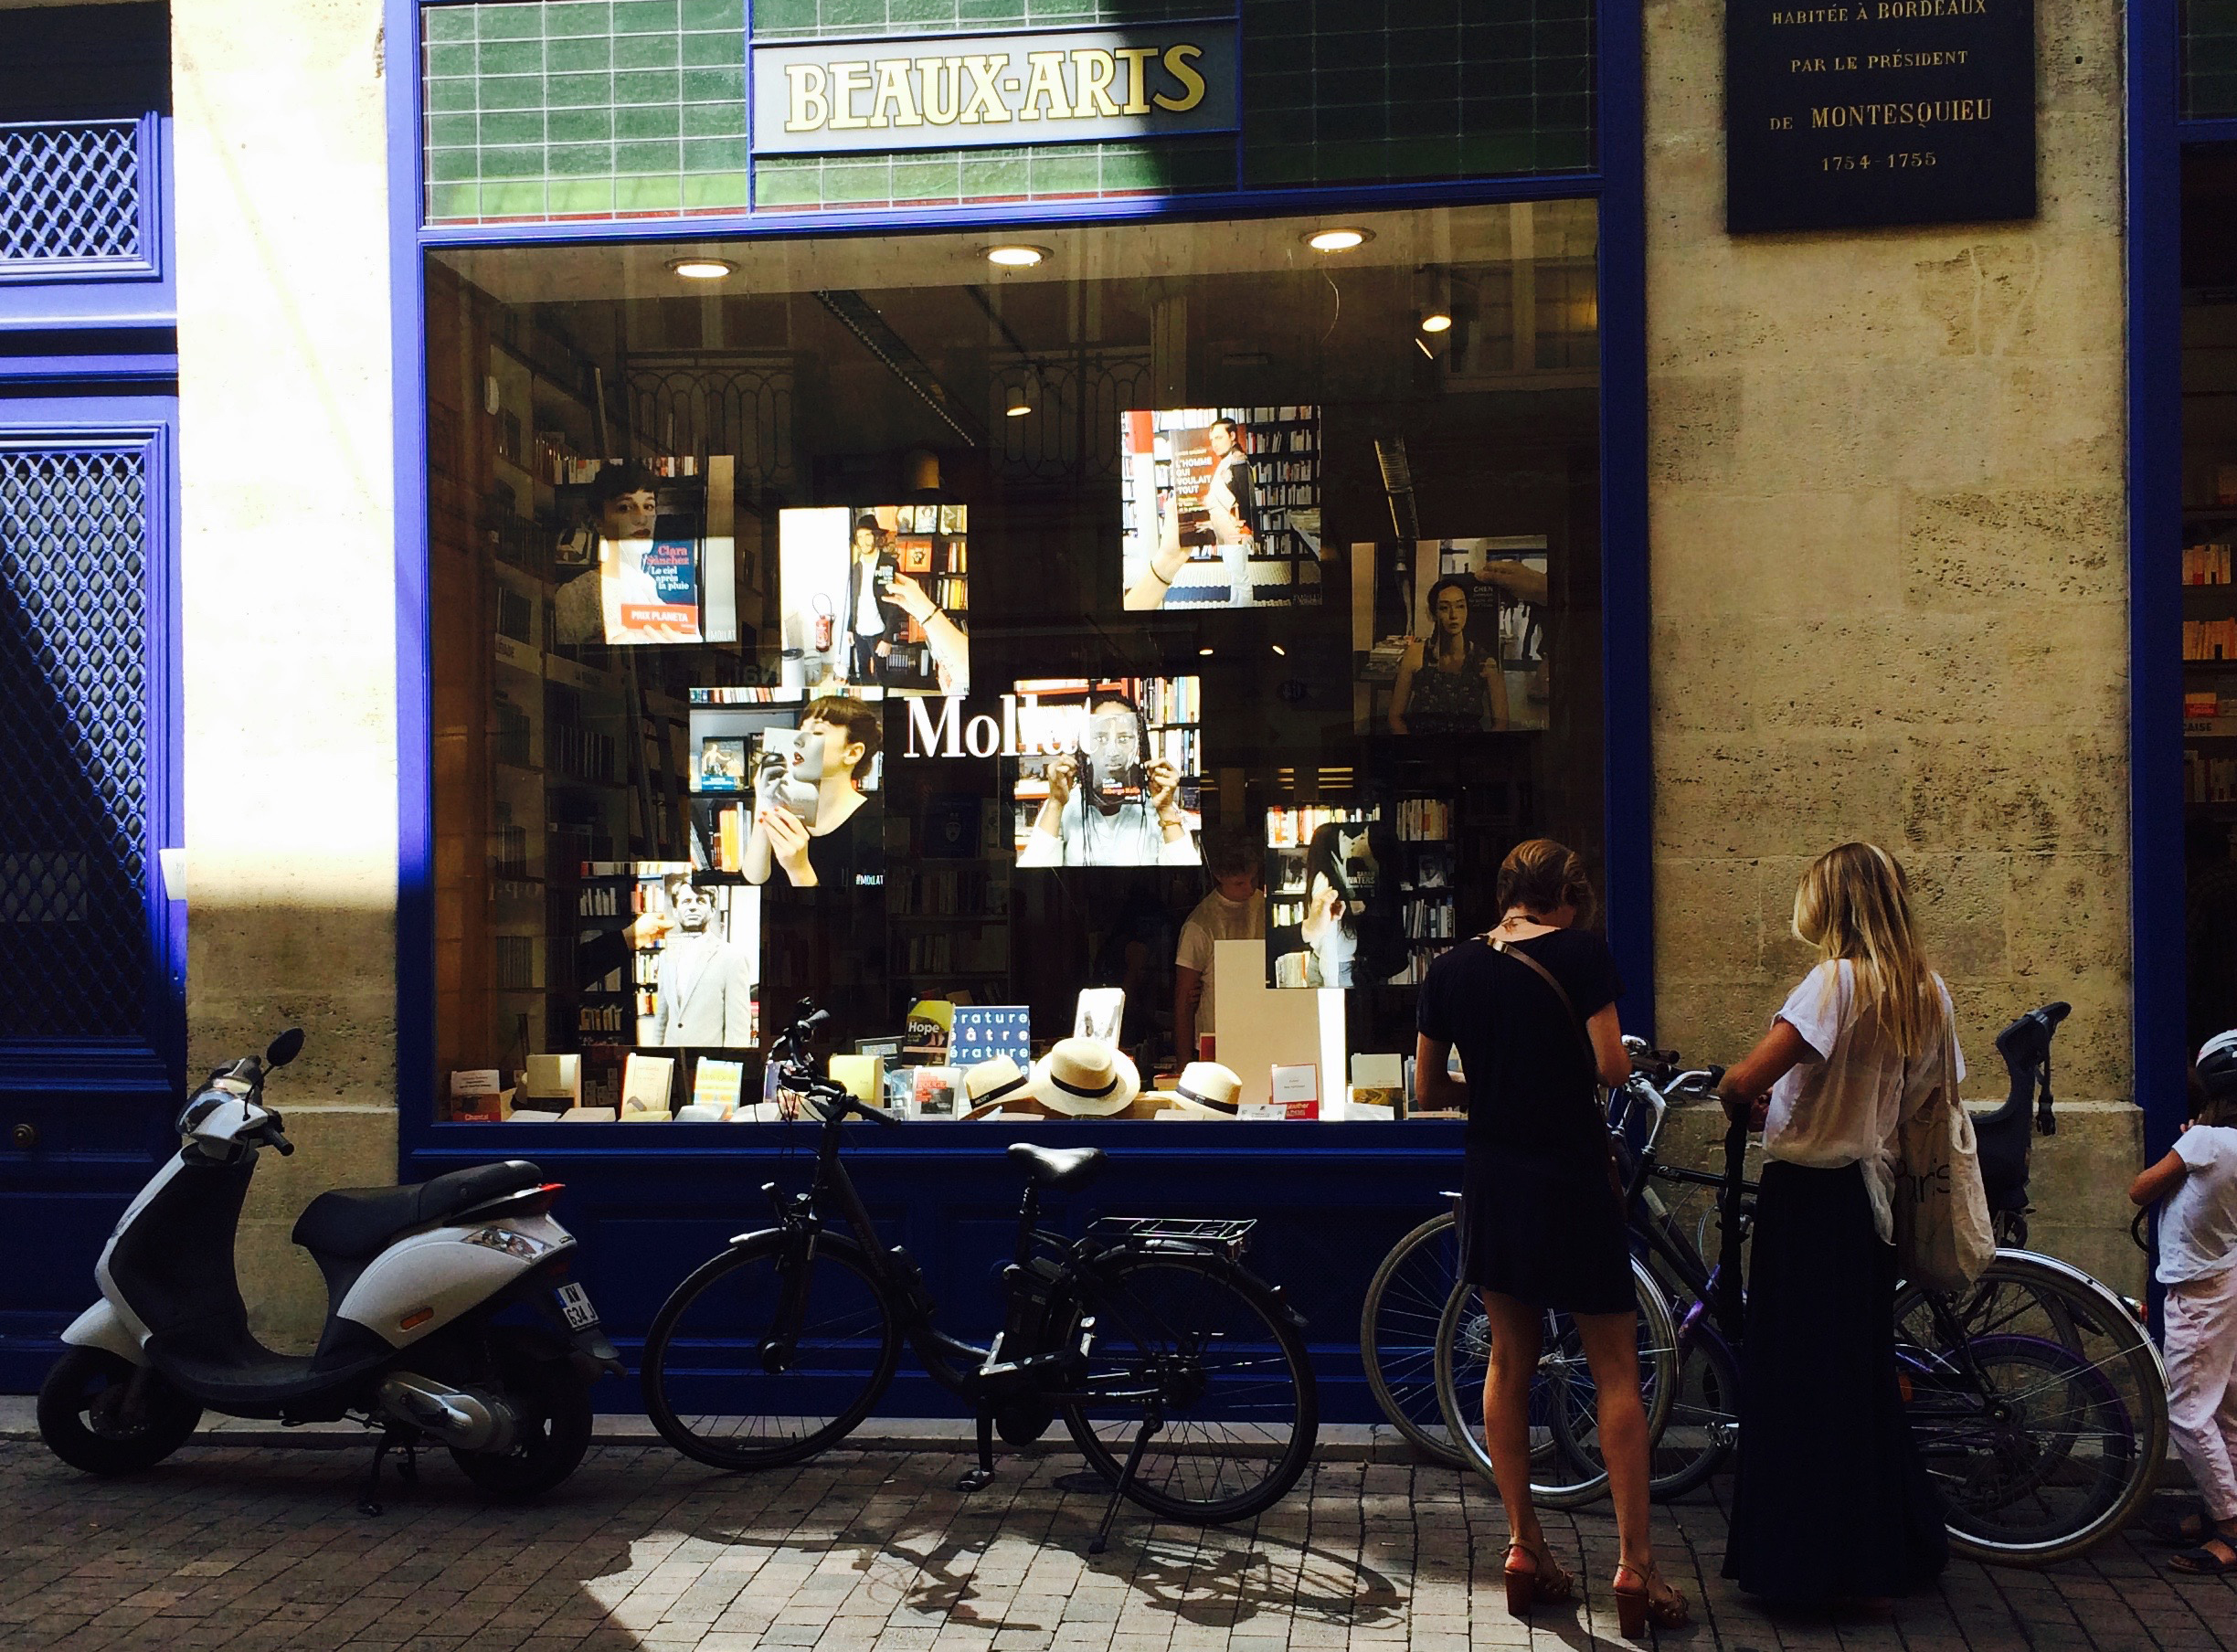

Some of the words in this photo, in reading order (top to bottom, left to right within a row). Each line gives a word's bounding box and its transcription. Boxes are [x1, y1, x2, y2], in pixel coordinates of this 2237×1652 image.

[1772, 4, 1849, 25] HABITÉE
[1856, 3, 1868, 20] À
[1878, 0, 1987, 19] BORDEAUX
[1790, 58, 1827, 73] PAR
[1834, 56, 1858, 70] LE
[1867, 48, 1968, 69] PRÉSIDENT
[784, 43, 1207, 132] BEAUX-ARTS
[1770, 117, 1793, 131] DE
[1811, 99, 1992, 128] MONTESQUIEU
[658, 545, 687, 556] Clara
[651, 566, 663, 575] Le
[663, 566, 678, 575] ciel
[668, 581, 690, 592] pluie
[652, 611, 688, 622] PLANETA
[907, 1022, 940, 1035] Hope
